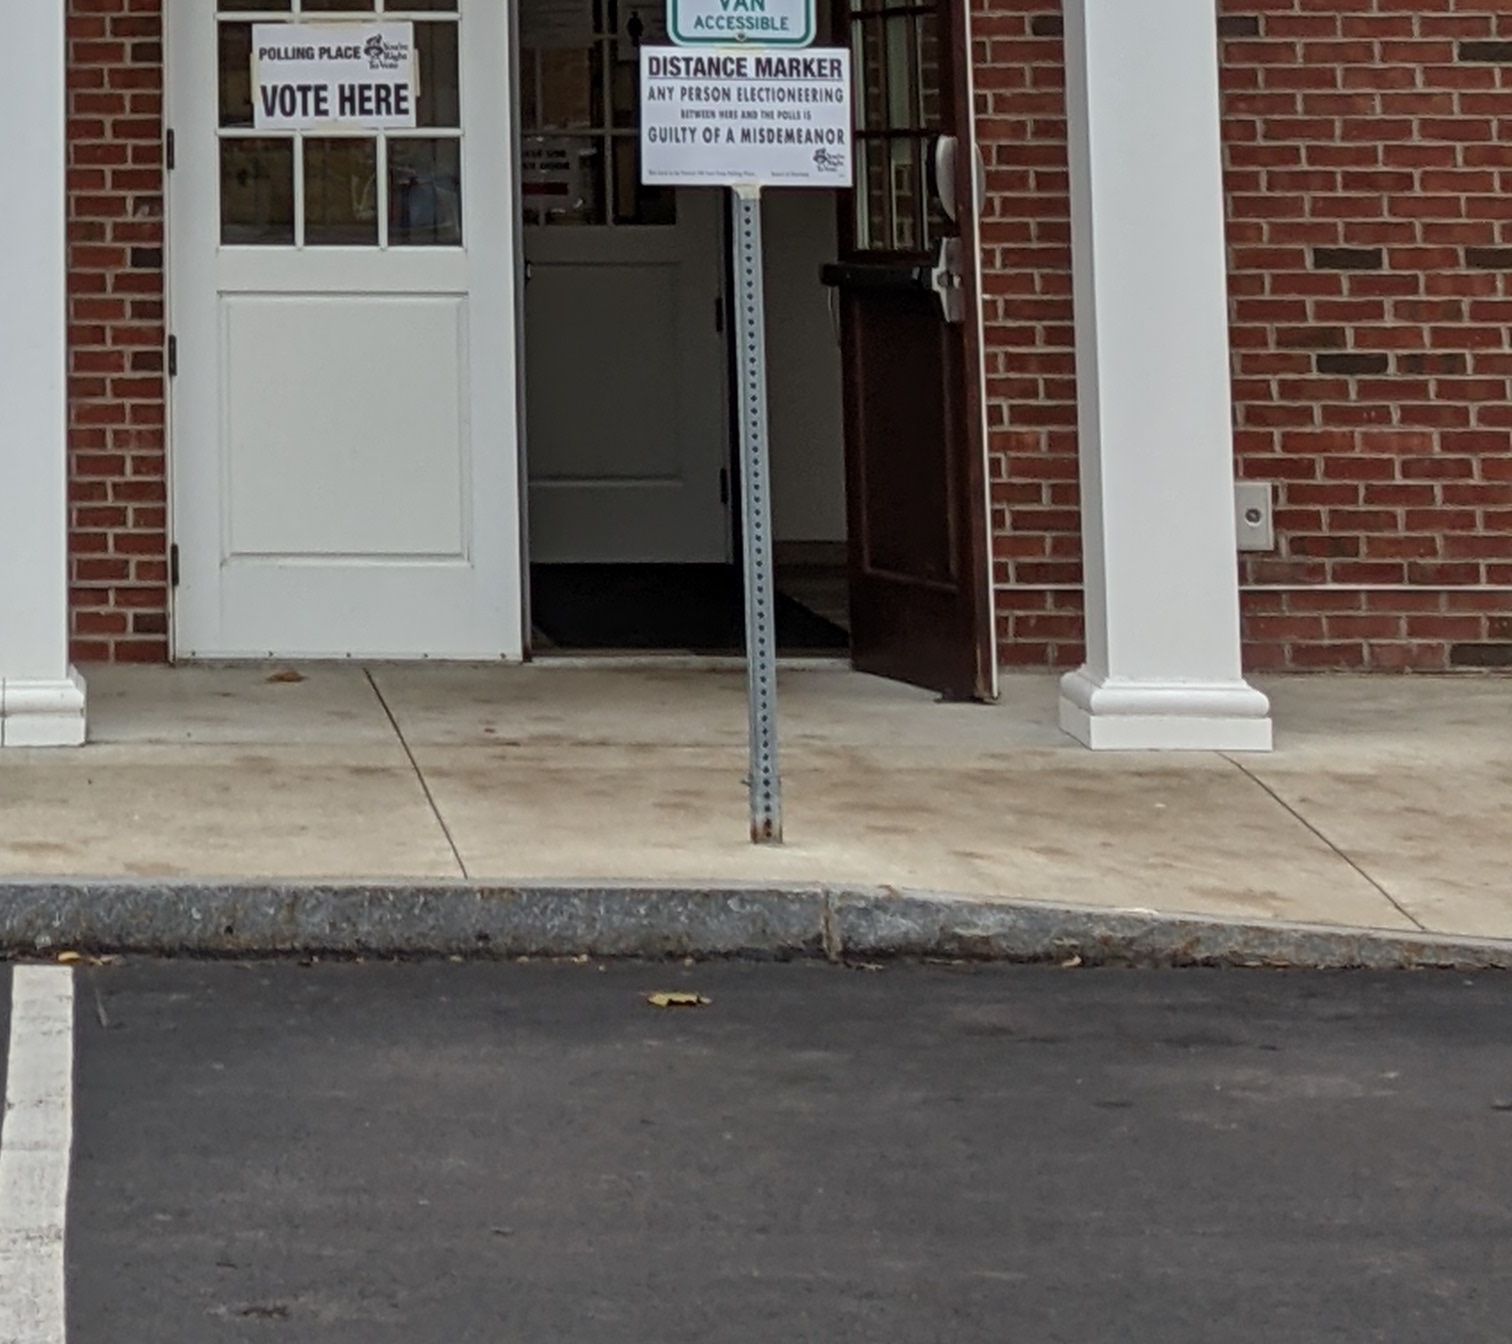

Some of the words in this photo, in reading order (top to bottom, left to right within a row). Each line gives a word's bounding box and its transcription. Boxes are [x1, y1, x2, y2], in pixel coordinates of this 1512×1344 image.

[693, 15, 790, 31] ACCESSIBLE
[259, 47, 315, 60] POLLING
[318, 46, 361, 60] PLACE
[648, 56, 748, 77] DISTANCE
[755, 57, 843, 78] MARKER
[260, 84, 329, 117] VOTE
[338, 83, 410, 116] HERE
[648, 86, 675, 101] ANY
[680, 86, 731, 102] PERSON
[737, 87, 844, 103] ELECTIONEERING
[681, 110, 716, 120] BETWEEN
[719, 110, 738, 120] HERE
[740, 110, 758, 120] AND
[760, 110, 775, 120] THE
[777, 110, 801, 120] POLLS
[803, 111, 812, 120] IS
[648, 127, 696, 143] GUILTY
[702, 127, 721, 143] OF
[726, 127, 735, 143] A
[740, 128, 845, 144] MISDEMEANOR
